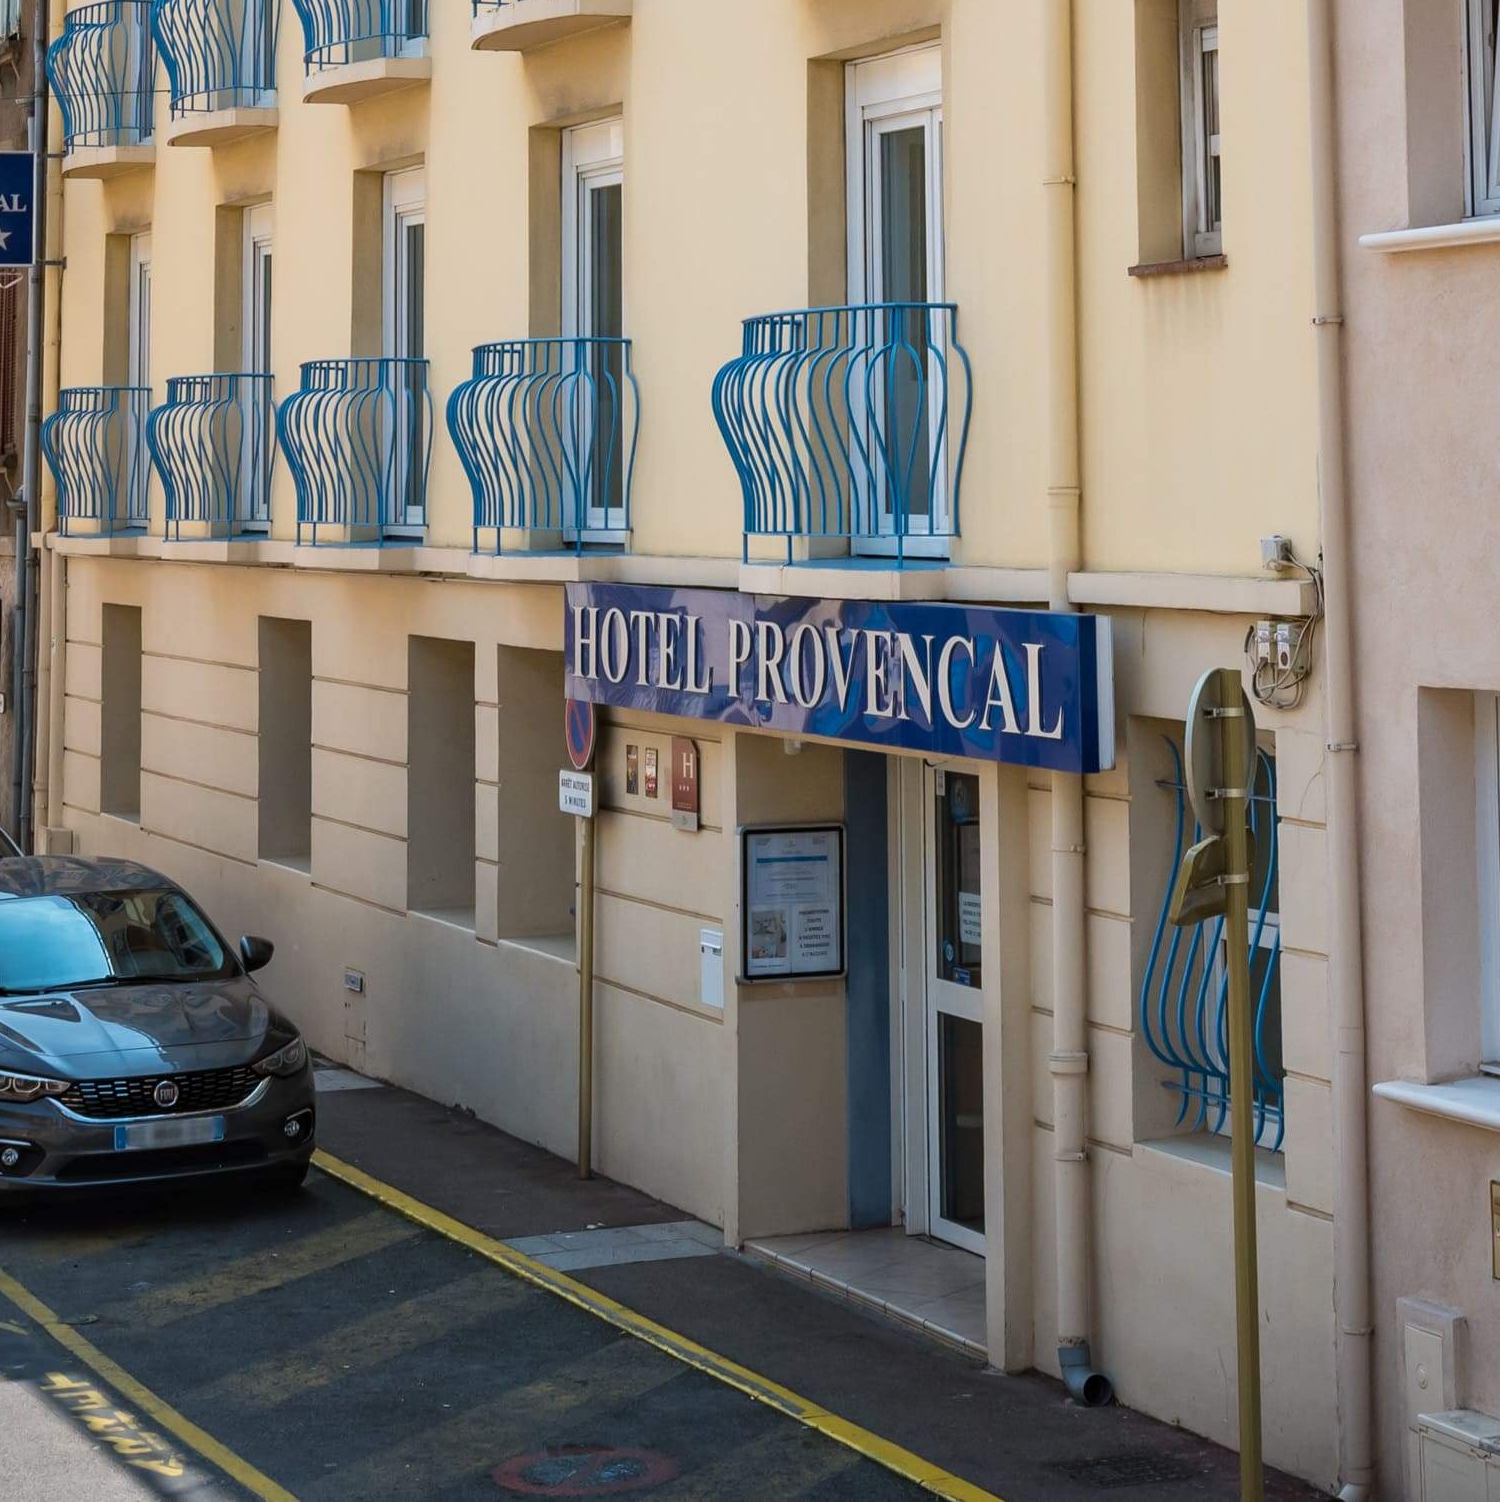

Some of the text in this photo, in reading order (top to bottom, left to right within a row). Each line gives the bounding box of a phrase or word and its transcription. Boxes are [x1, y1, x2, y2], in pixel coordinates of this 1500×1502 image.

[571, 605, 1064, 741] HOTEL PROVENCAL
[682, 752, 694, 779] H
[160, 1088, 174, 1101] FIAT
